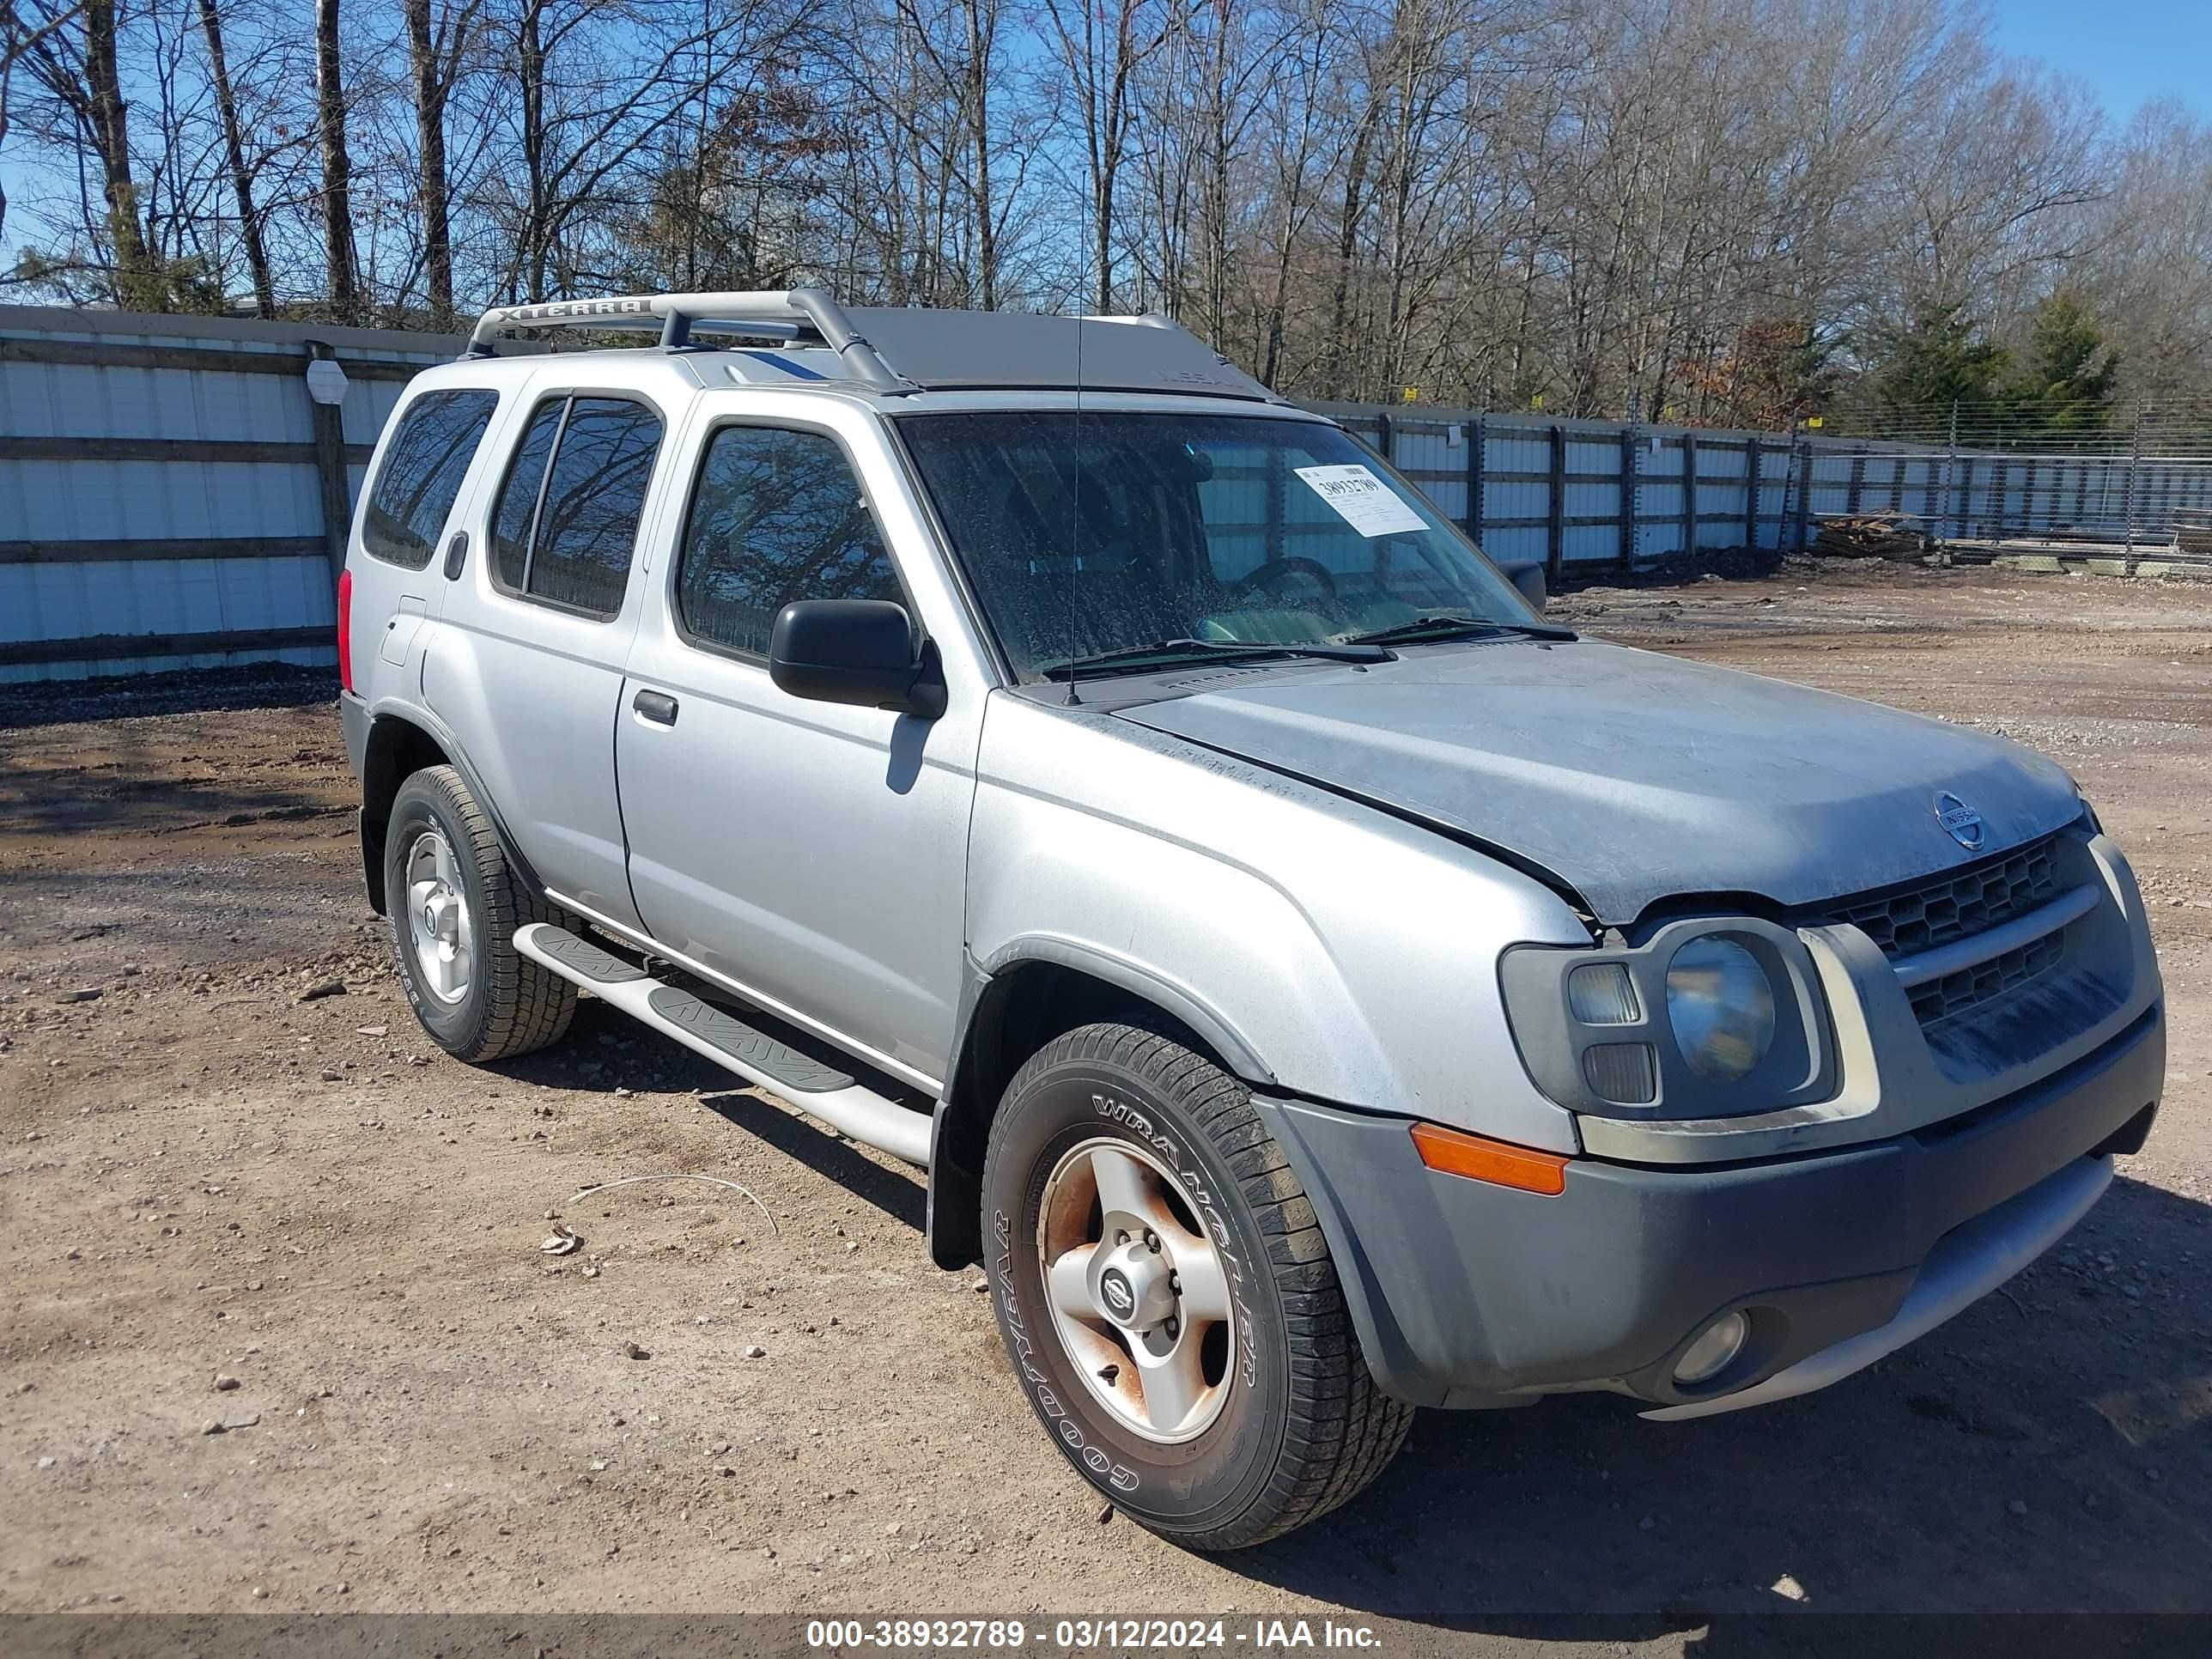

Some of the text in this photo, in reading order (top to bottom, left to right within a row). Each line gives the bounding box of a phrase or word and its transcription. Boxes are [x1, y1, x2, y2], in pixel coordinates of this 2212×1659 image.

[497, 301, 641, 322] XTERRA
[1318, 477, 1380, 496] 38932789
[1091, 1095, 1258, 1388] WRANGLER
[994, 1209, 1140, 1492] GOODYEAR
